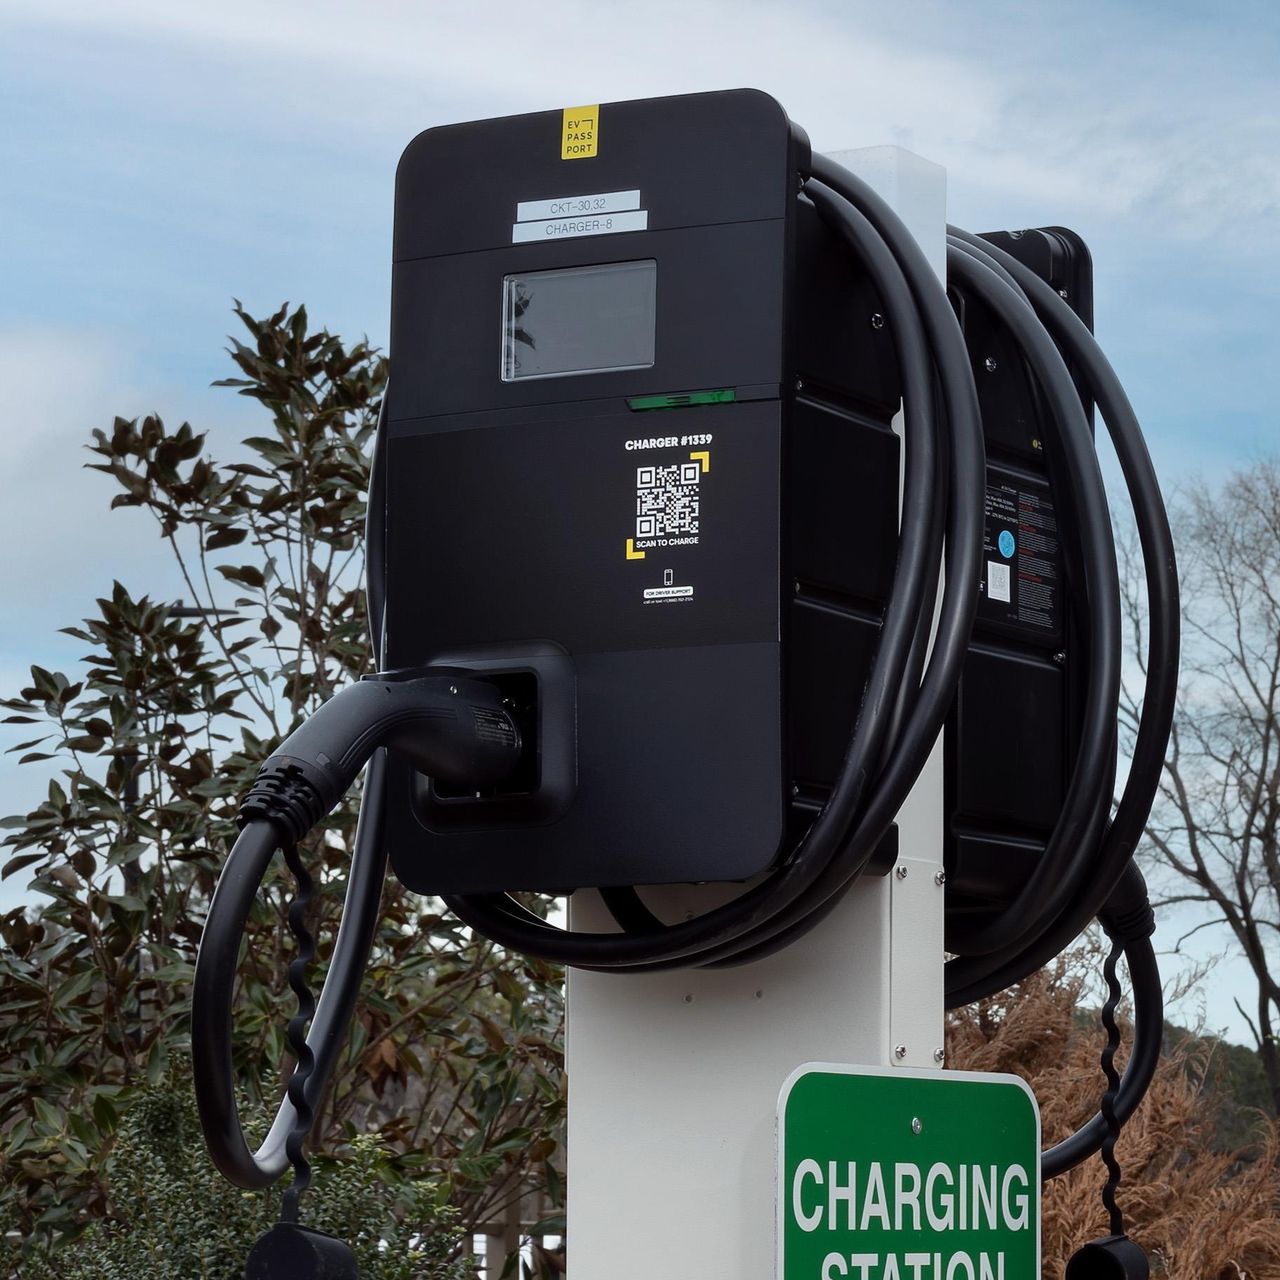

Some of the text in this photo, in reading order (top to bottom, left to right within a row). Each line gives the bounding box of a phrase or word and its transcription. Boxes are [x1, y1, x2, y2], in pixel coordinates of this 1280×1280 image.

[568, 120, 581, 129] EV
[567, 132, 593, 141] PASS
[566, 144, 593, 154] PORT
[545, 218, 613, 235] CHARGER-8
[625, 434, 713, 450] CHARGER #1339
[636, 537, 699, 548] SCAN TO CHARGE
[793, 1158, 1029, 1232] CHARGING
